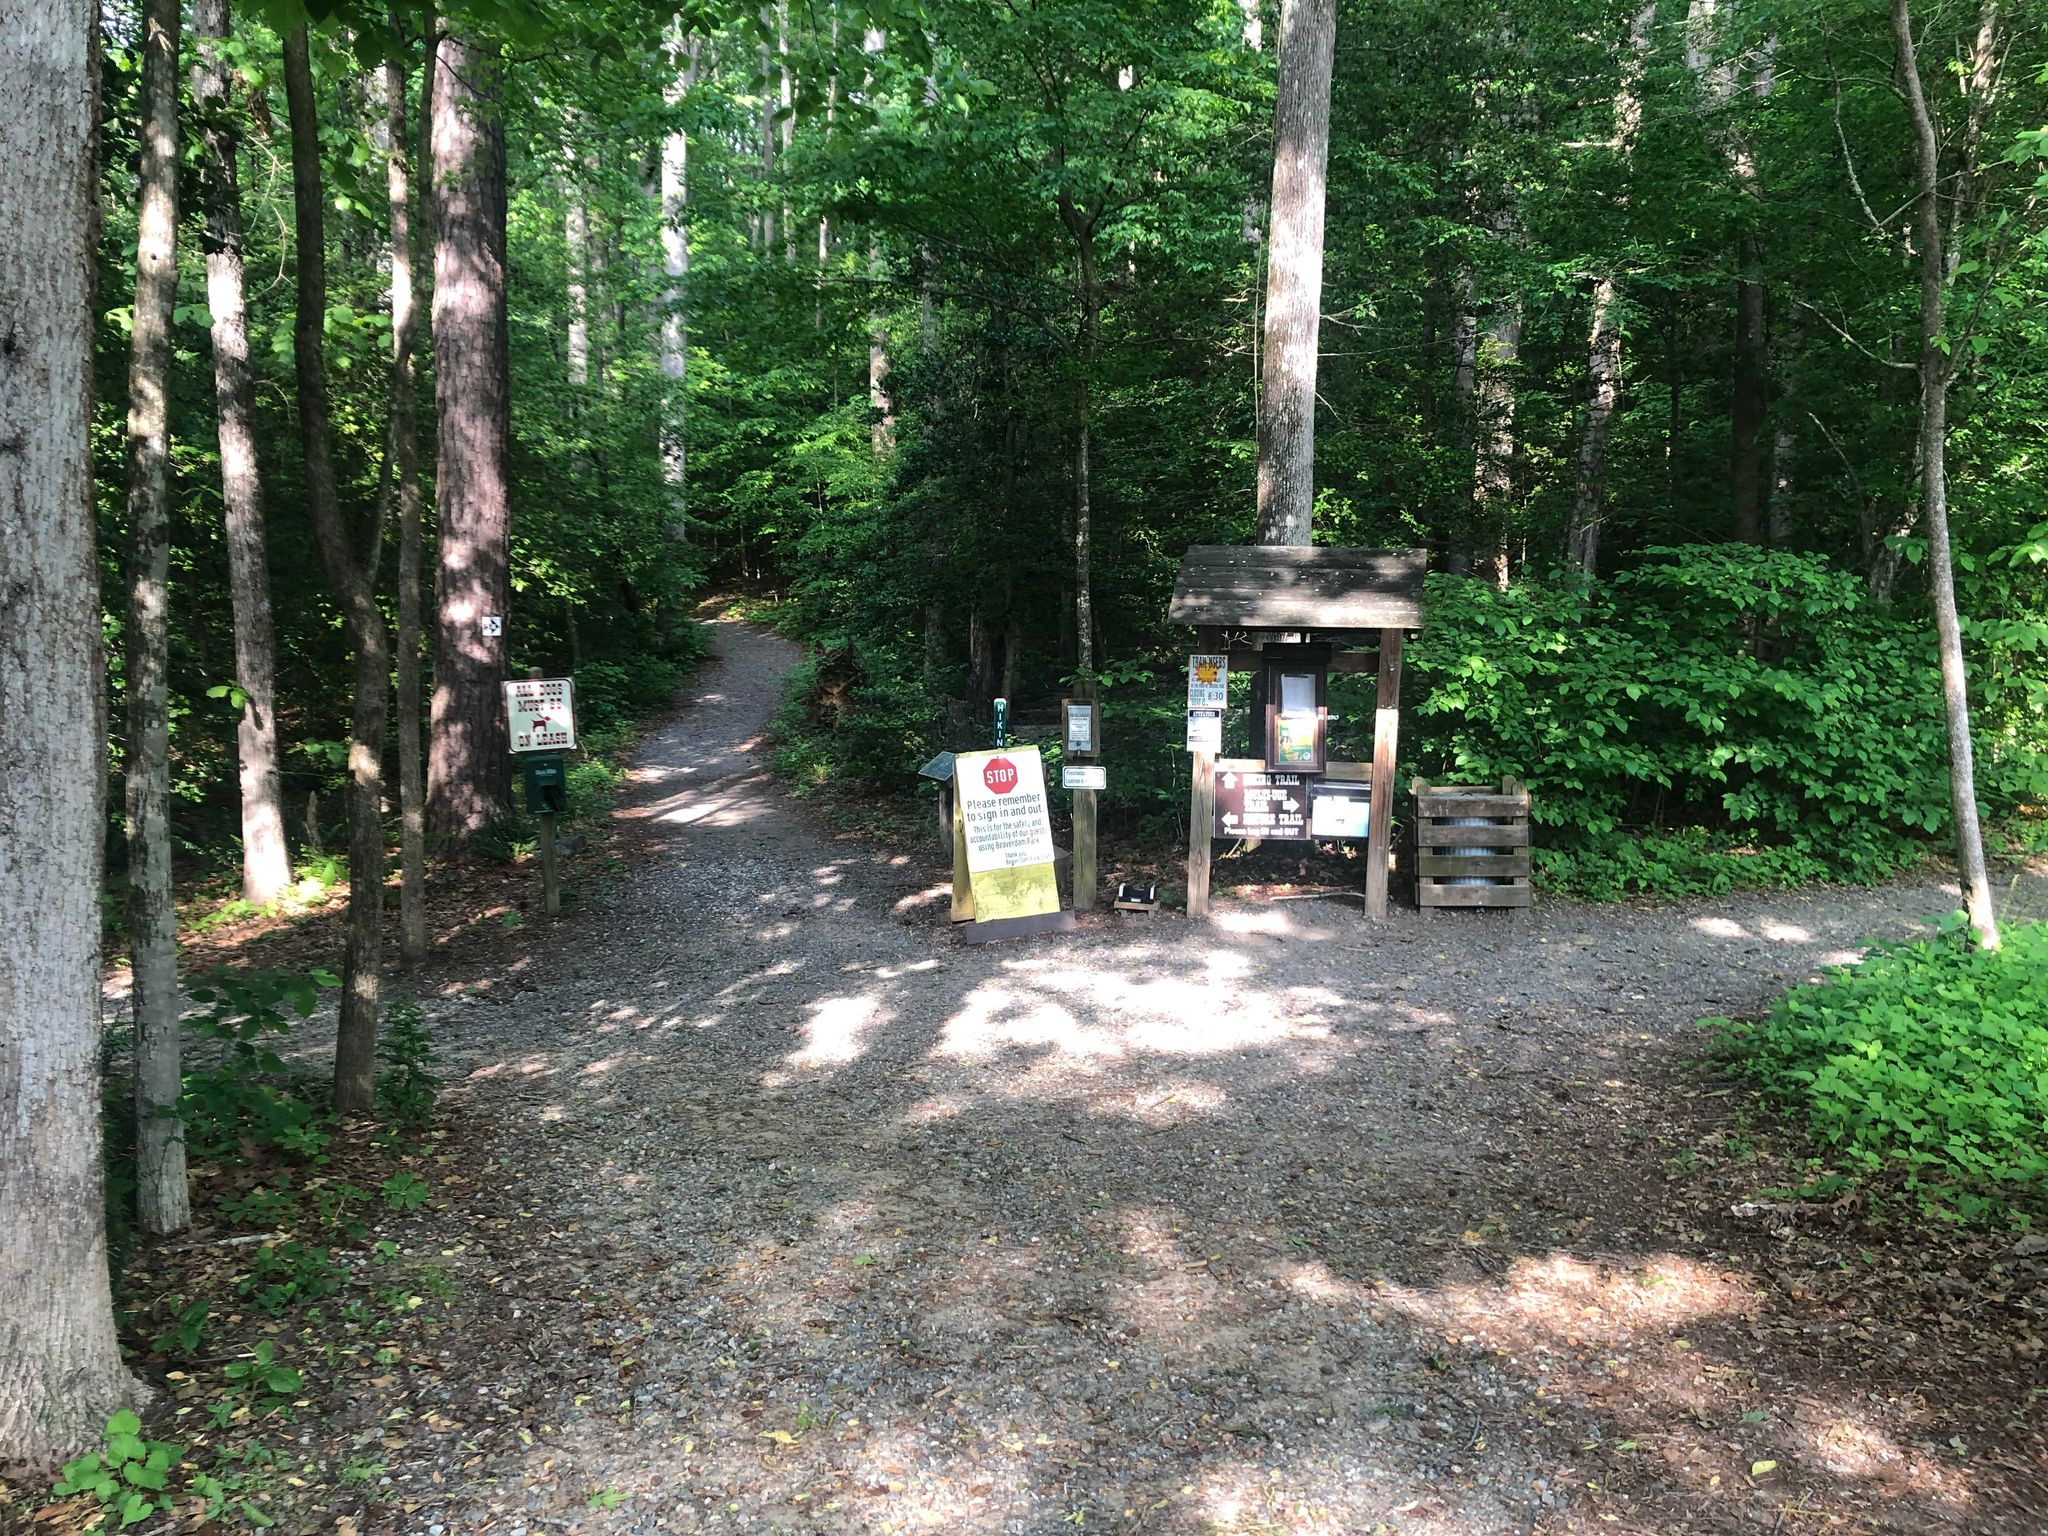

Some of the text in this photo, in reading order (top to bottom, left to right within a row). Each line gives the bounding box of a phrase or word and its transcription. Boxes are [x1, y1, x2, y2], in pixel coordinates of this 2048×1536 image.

[539, 683, 562, 696] DOGS
[1208, 692, 1224, 701] 8:30
[517, 699, 545, 712] MUST
[996, 704, 1004, 747] HIKIN
[537, 732, 568, 746] LEASH
[986, 768, 1014, 784] STOP
[1275, 774, 1300, 786] TRAIL
[967, 793, 1041, 810] Please remember
[967, 812, 976, 822] to
[978, 810, 997, 822] sign
[1000, 807, 1009, 818] in
[1010, 805, 1026, 817] and
[1278, 814, 1304, 826] TRAIL
[973, 823, 986, 833] This
[987, 823, 993, 831] is
[993, 822, 1002, 831] for
[1003, 821, 1013, 830] the
[1031, 818, 1042, 826] and
[1283, 827, 1300, 836] OUT
[970, 831, 1011, 844] accountability
[1012, 830, 1018, 838] of
[1019, 829, 1028, 837] our
[978, 842, 995, 852] using
[995, 839, 1026, 850] Beaverdam
